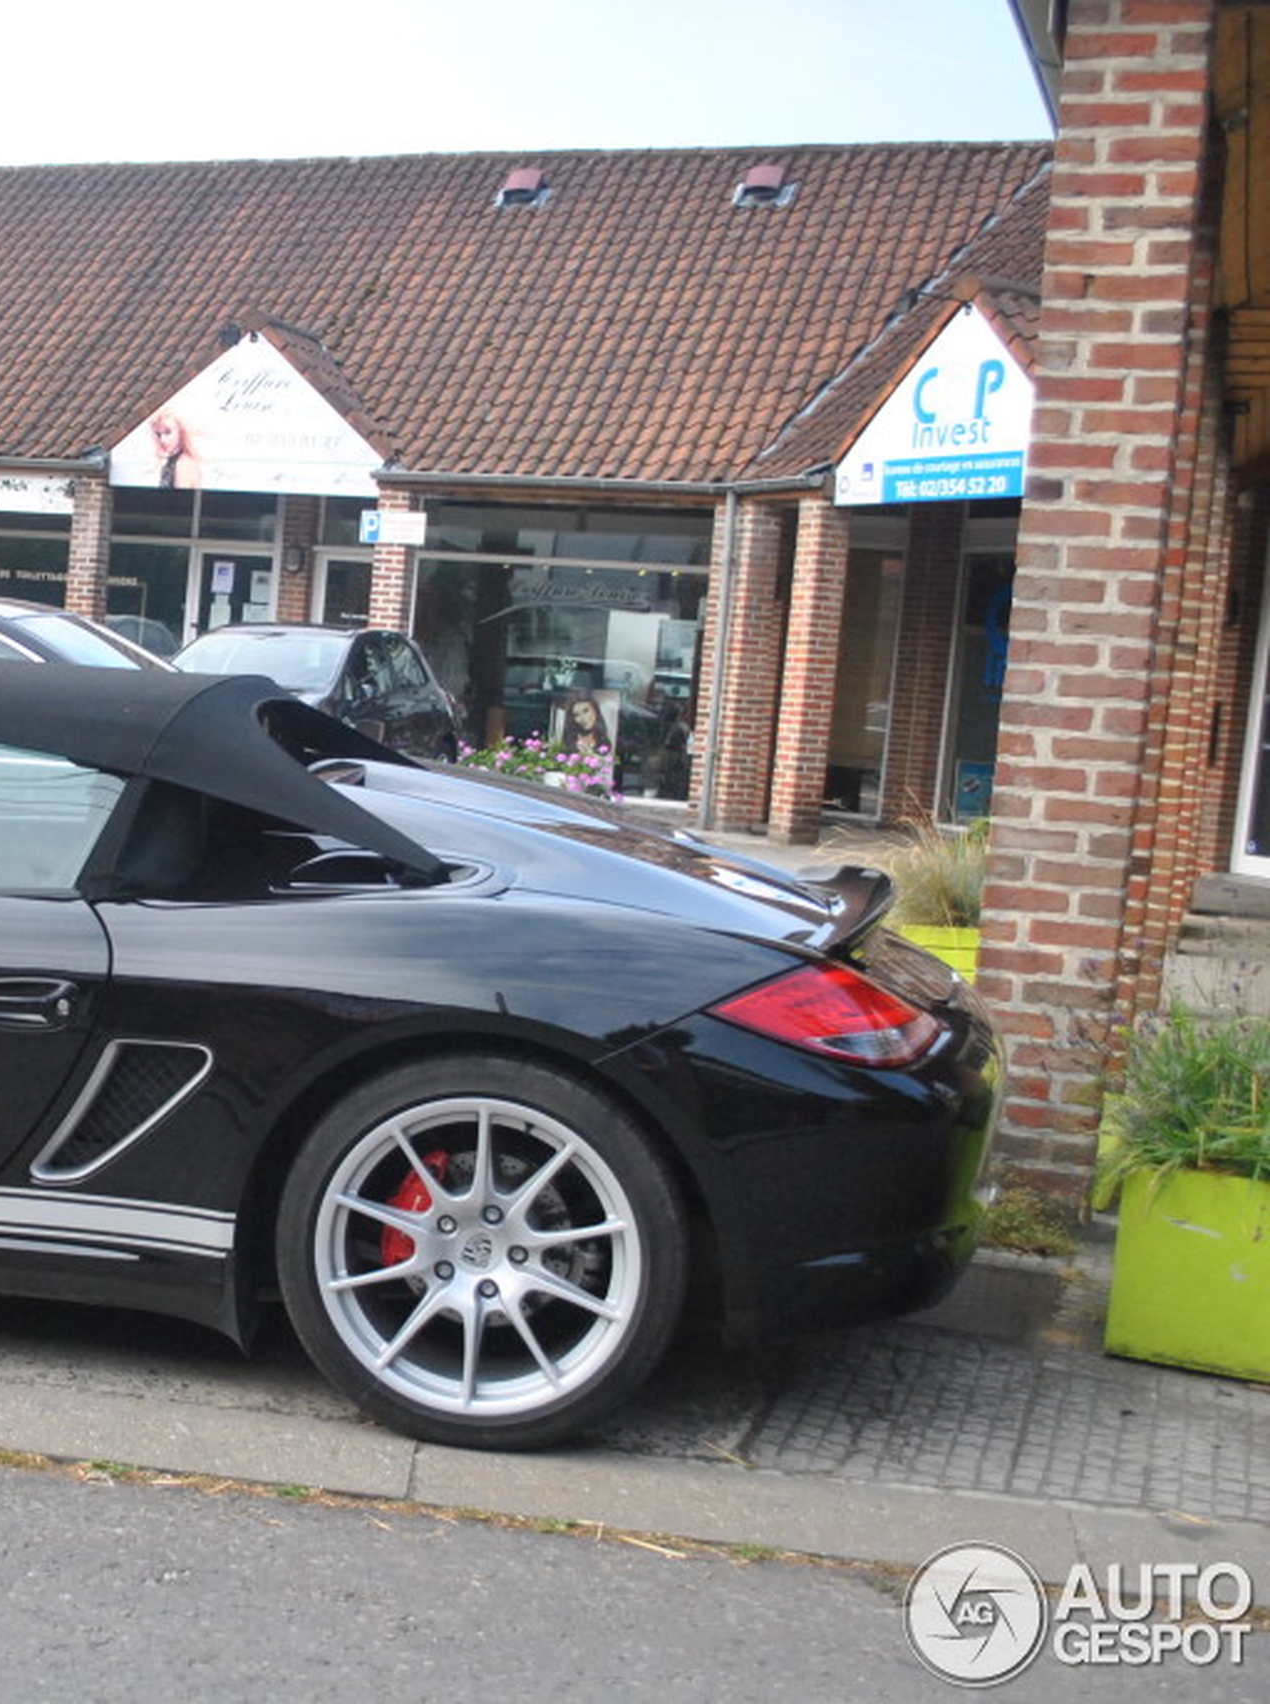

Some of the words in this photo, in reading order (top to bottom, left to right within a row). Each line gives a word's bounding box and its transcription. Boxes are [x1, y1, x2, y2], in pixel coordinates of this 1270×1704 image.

[913, 366, 939, 424] C
[973, 359, 1006, 419] P
[912, 417, 993, 449] Invest
[987, 476, 1006, 493] 20
